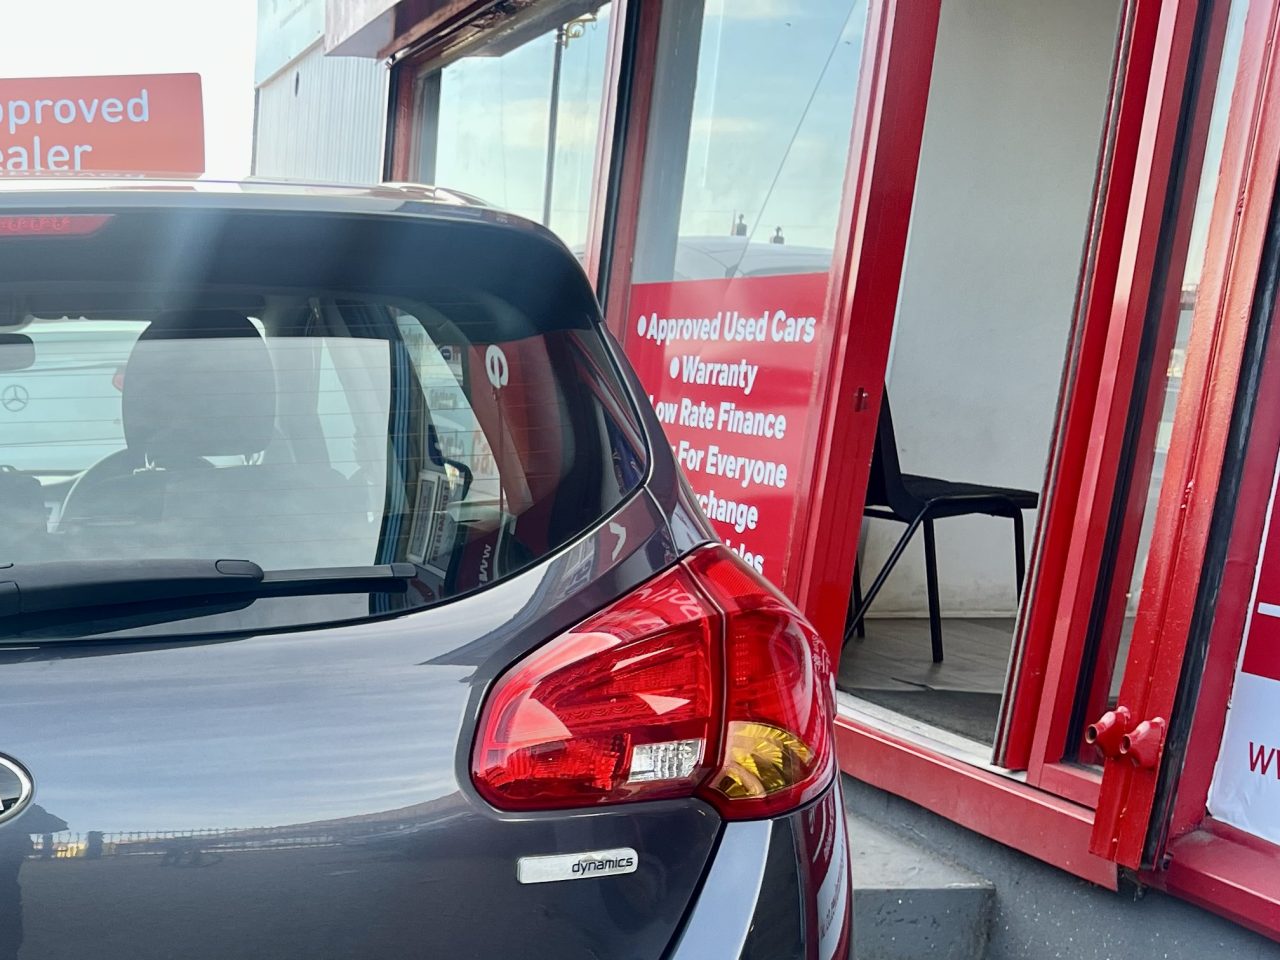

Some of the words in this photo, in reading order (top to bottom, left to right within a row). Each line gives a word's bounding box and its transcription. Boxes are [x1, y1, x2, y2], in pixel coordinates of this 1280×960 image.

[646, 312, 722, 346] Approved
[724, 311, 769, 342] Used
[771, 309, 816, 343] Cars
[682, 355, 758, 395] Warranty
[649, 395, 678, 424] ow
[680, 398, 715, 430] Rate
[717, 401, 787, 439] Finance
[678, 440, 705, 471] For
[705, 445, 787, 488] Everyone
[696, 489, 759, 534] change
[571, 857, 634, 875] dynamics
